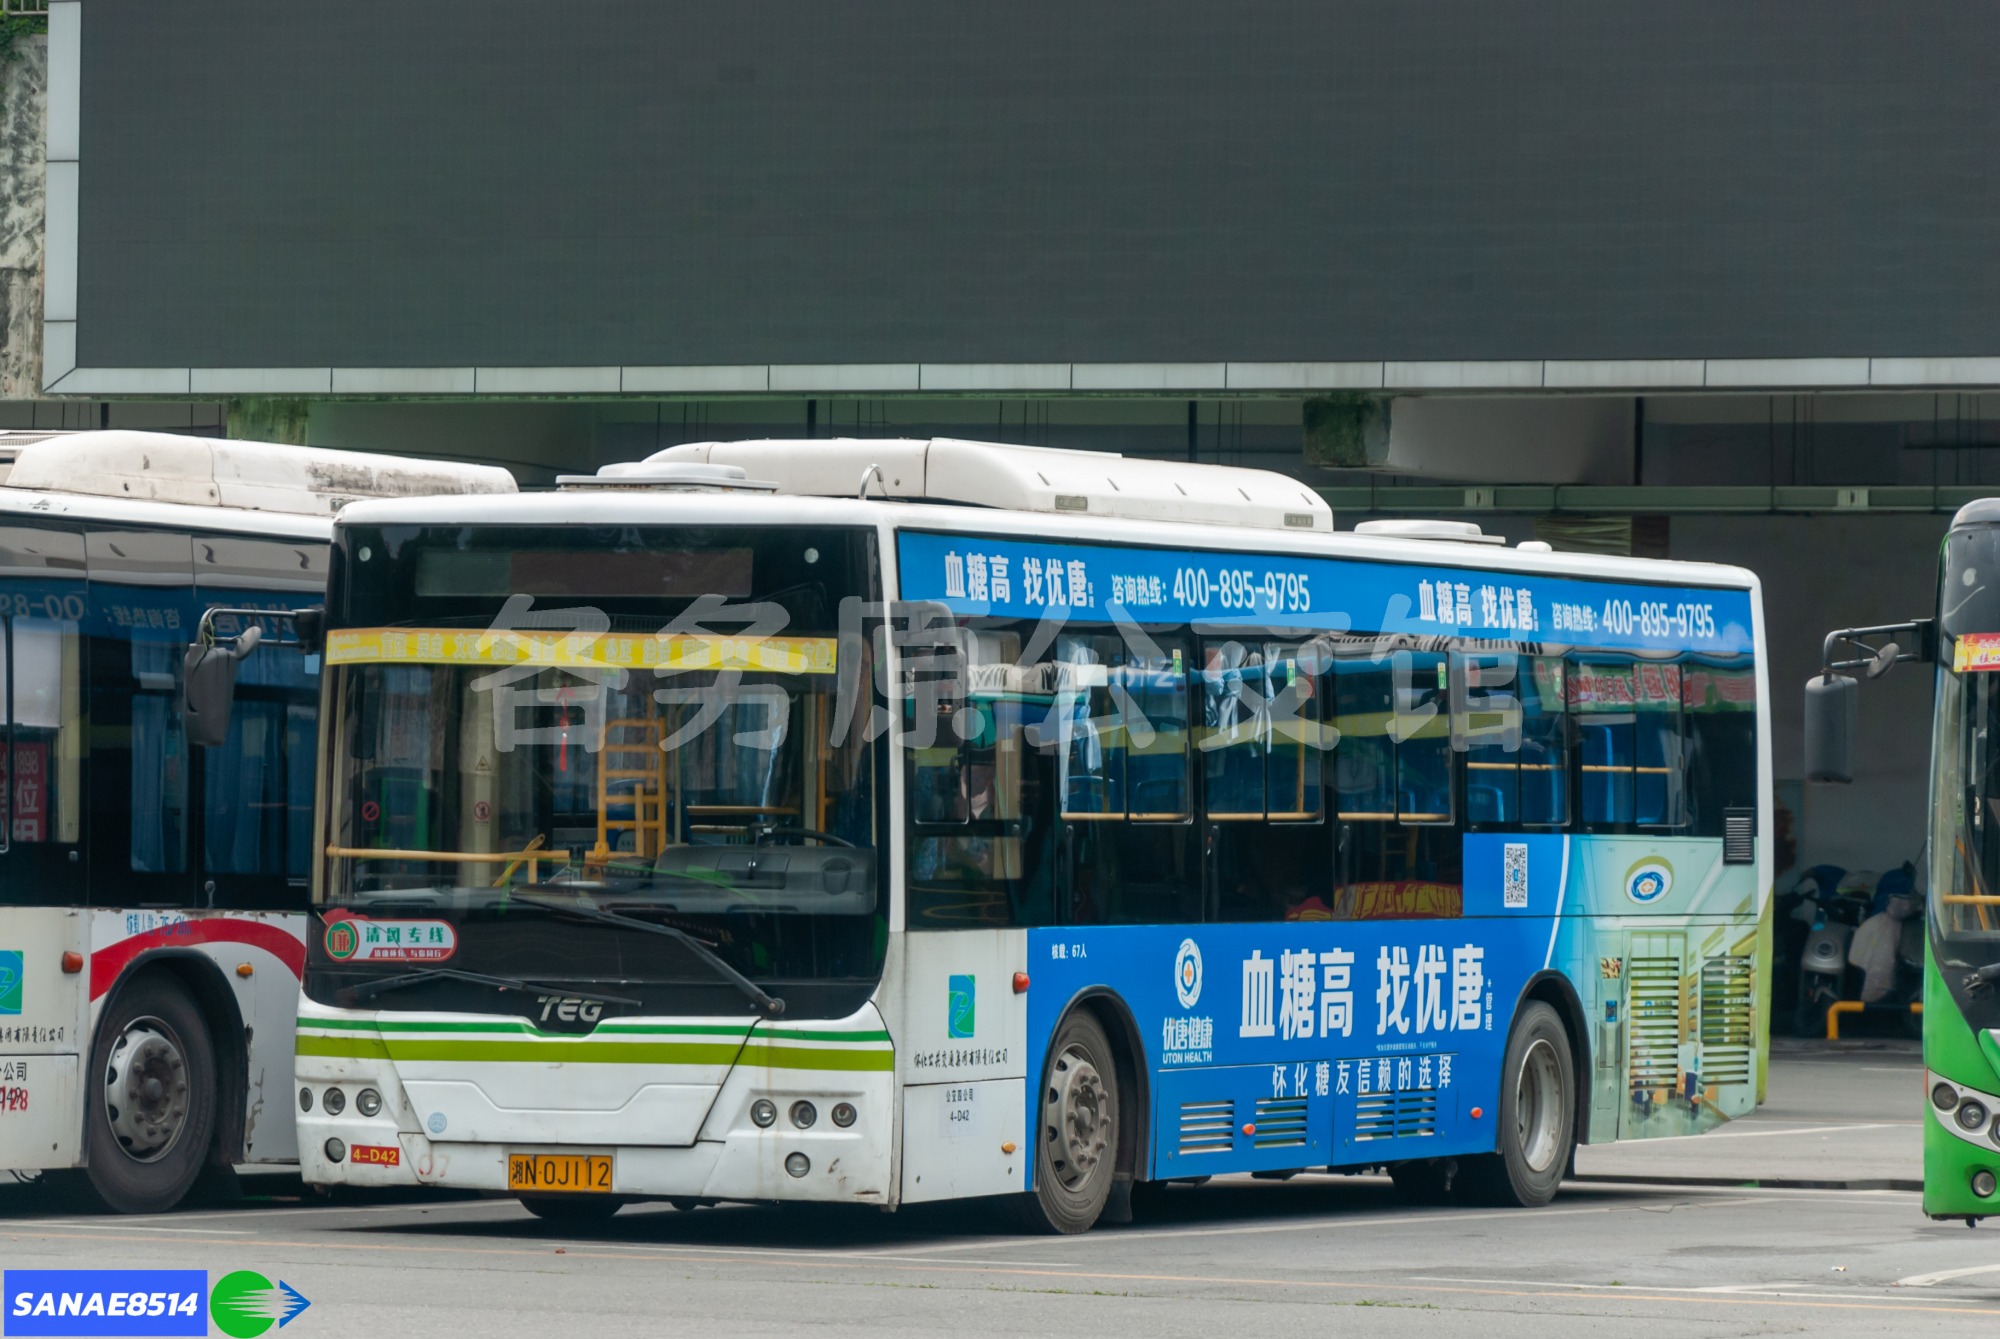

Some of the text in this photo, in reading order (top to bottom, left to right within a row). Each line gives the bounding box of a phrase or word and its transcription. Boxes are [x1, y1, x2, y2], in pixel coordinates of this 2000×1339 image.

[945, 550, 1010, 603] 血糖高
[1023, 556, 1087, 607] 找优唐
[1173, 567, 1311, 612] 400-895-9795
[1418, 579, 1472, 627] 血糖高
[1481, 585, 1533, 632] 找优唐
[1602, 599, 1715, 639] 400-895-9795
[366, 926, 443, 943] 清风专线
[1239, 943, 1484, 1041] 血糖高 找优唐
[1163, 1016, 1213, 1051] 优唐健康
[0, 1062, 27, 1081] 公司
[1163, 1050, 1213, 1064] UTON HEALTH
[1273, 1055, 1452, 1098] 怀化糖友信赖的选择
[950, 1109, 970, 1122] 4-D42
[353, 1149, 397, 1164] 4-D42
